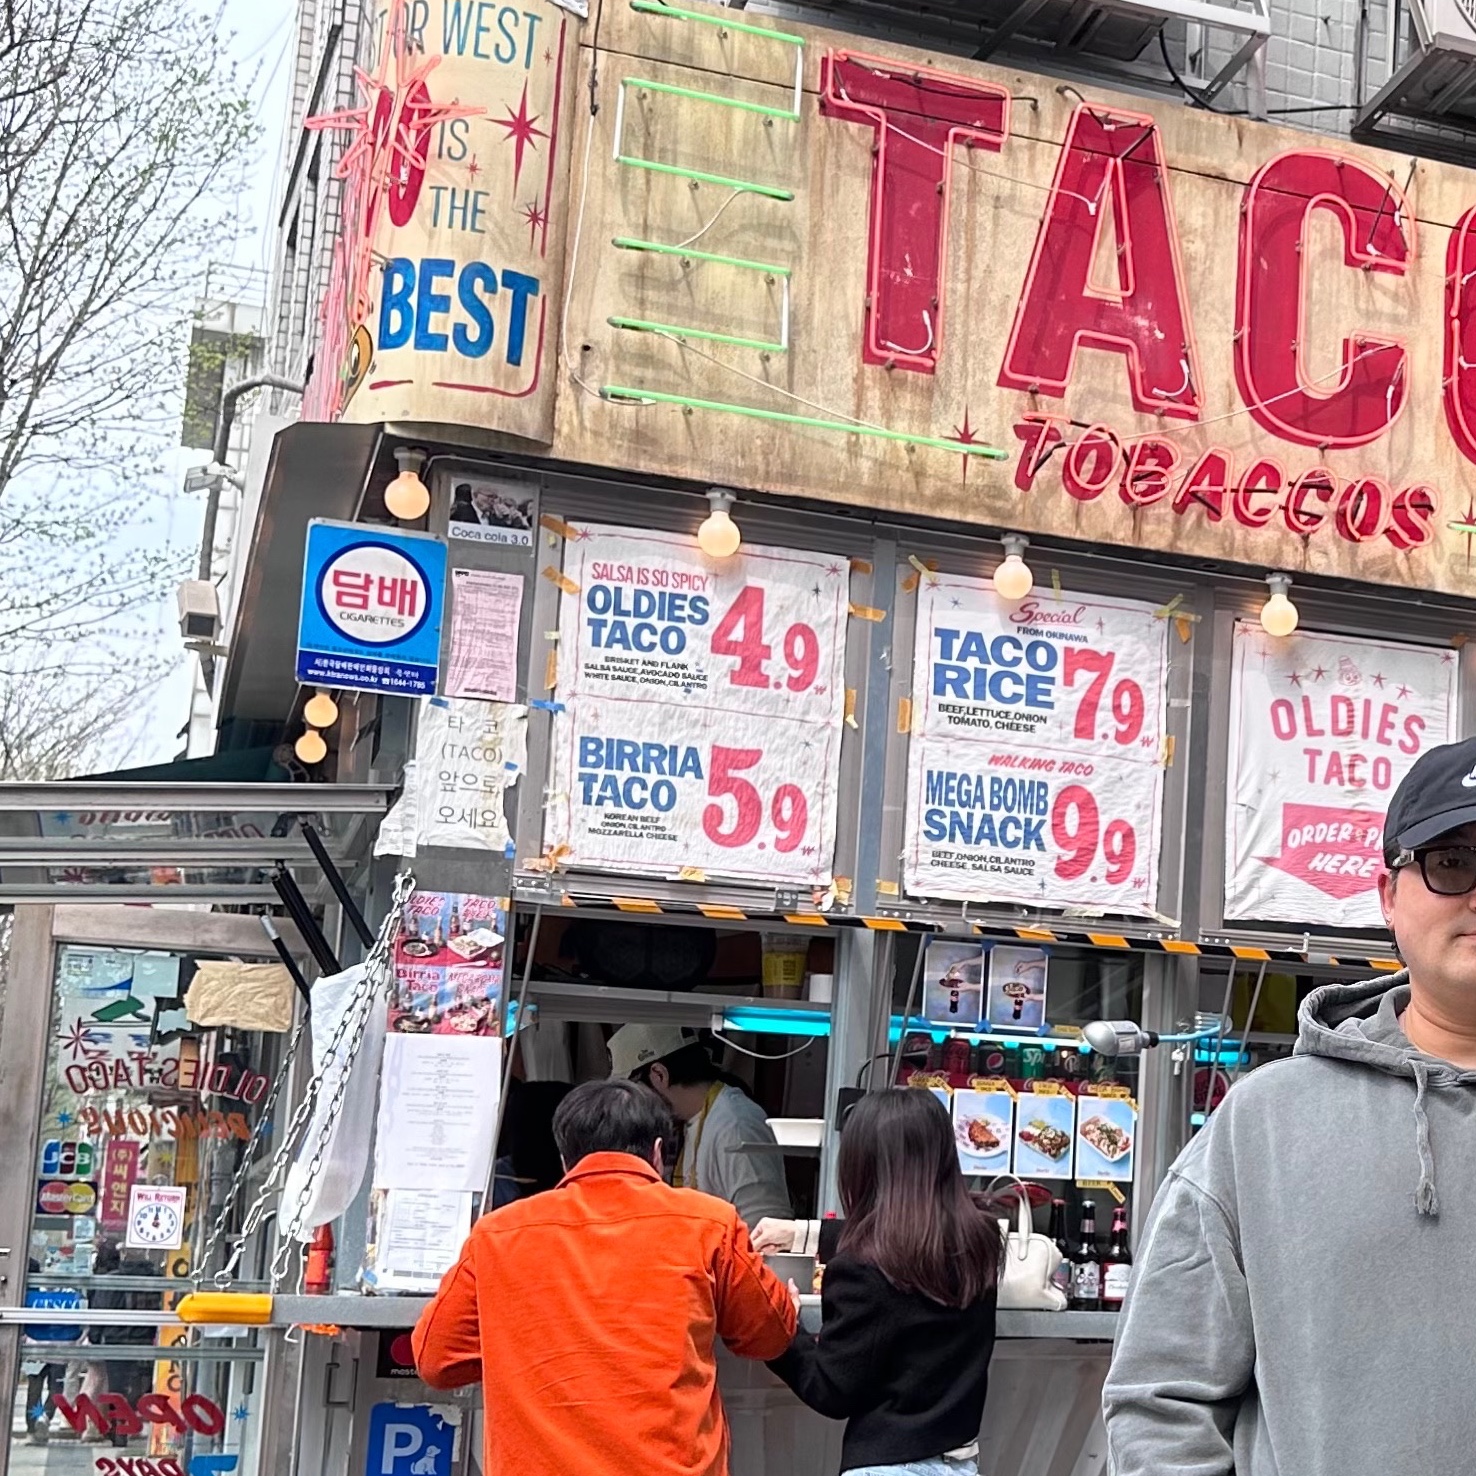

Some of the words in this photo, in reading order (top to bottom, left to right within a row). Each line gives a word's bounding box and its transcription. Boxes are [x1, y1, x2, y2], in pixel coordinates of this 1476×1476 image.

[443, 0, 542, 69] WEST
[438, 119, 470, 162] IS
[429, 185, 490, 234] THE
[377, 257, 540, 367] BEST
[1012, 410, 1442, 550] TOBACCOS
[451, 526, 481, 541] Coca
[484, 530, 508, 543] cola
[510, 533, 530, 546] 3.0
[592, 562, 635, 583] SALSA
[637, 567, 650, 584] IS
[652, 569, 669, 586] SO
[671, 570, 709, 592] SPICY
[333, 569, 418, 617] 담배
[587, 584, 710, 626] OLDIES
[339, 611, 405, 628] CIGARETTES
[1009, 601, 1087, 626] Special
[587, 618, 687, 656] TACO
[1017, 626, 1044, 638] FROM
[1046, 630, 1089, 644] OKINAWA
[934, 627, 1059, 672] TACO
[584, 663, 611, 672] SALSA
[681, 673, 709, 682] SAUCE
[584, 671, 610, 681] WHITE
[604, 656, 640, 666] BRISKET
[641, 659, 660, 668] AND
[661, 661, 689, 671] FLANK
[932, 662, 1056, 710] RICE
[994, 720, 1036, 734] CHEESE
[1270, 694, 1426, 755] OLDIES
[442, 745, 503, 764] (TACO)
[578, 736, 704, 780] BIRRIA
[988, 754, 1056, 773] WALKING
[1057, 760, 1094, 777] TACO
[1303, 748, 1392, 791] TACO
[438, 771, 500, 799] 앞으로
[578, 772, 678, 812] TACO
[926, 770, 986, 810] MEGA
[989, 777, 1050, 817] BOMB
[436, 806, 500, 831] 오세요
[604, 813, 639, 822] KOREAN
[639, 816, 662, 824] BEEF
[923, 809, 1048, 852] SNACK
[588, 827, 644, 838] MOZZARELLA
[645, 833, 679, 842] CHEESE
[1287, 822, 1354, 849] ORDER
[971, 863, 1003, 874] SALSA
[1004, 865, 1035, 877] SAUCE
[1308, 852, 1379, 878] HERE
[406, 905, 440, 916] TACO
[396, 968, 440, 979] Birria
[406, 980, 439, 993] Taco
[41, 1191, 96, 1203] MasterCard
[381, 1423, 424, 1475] P
